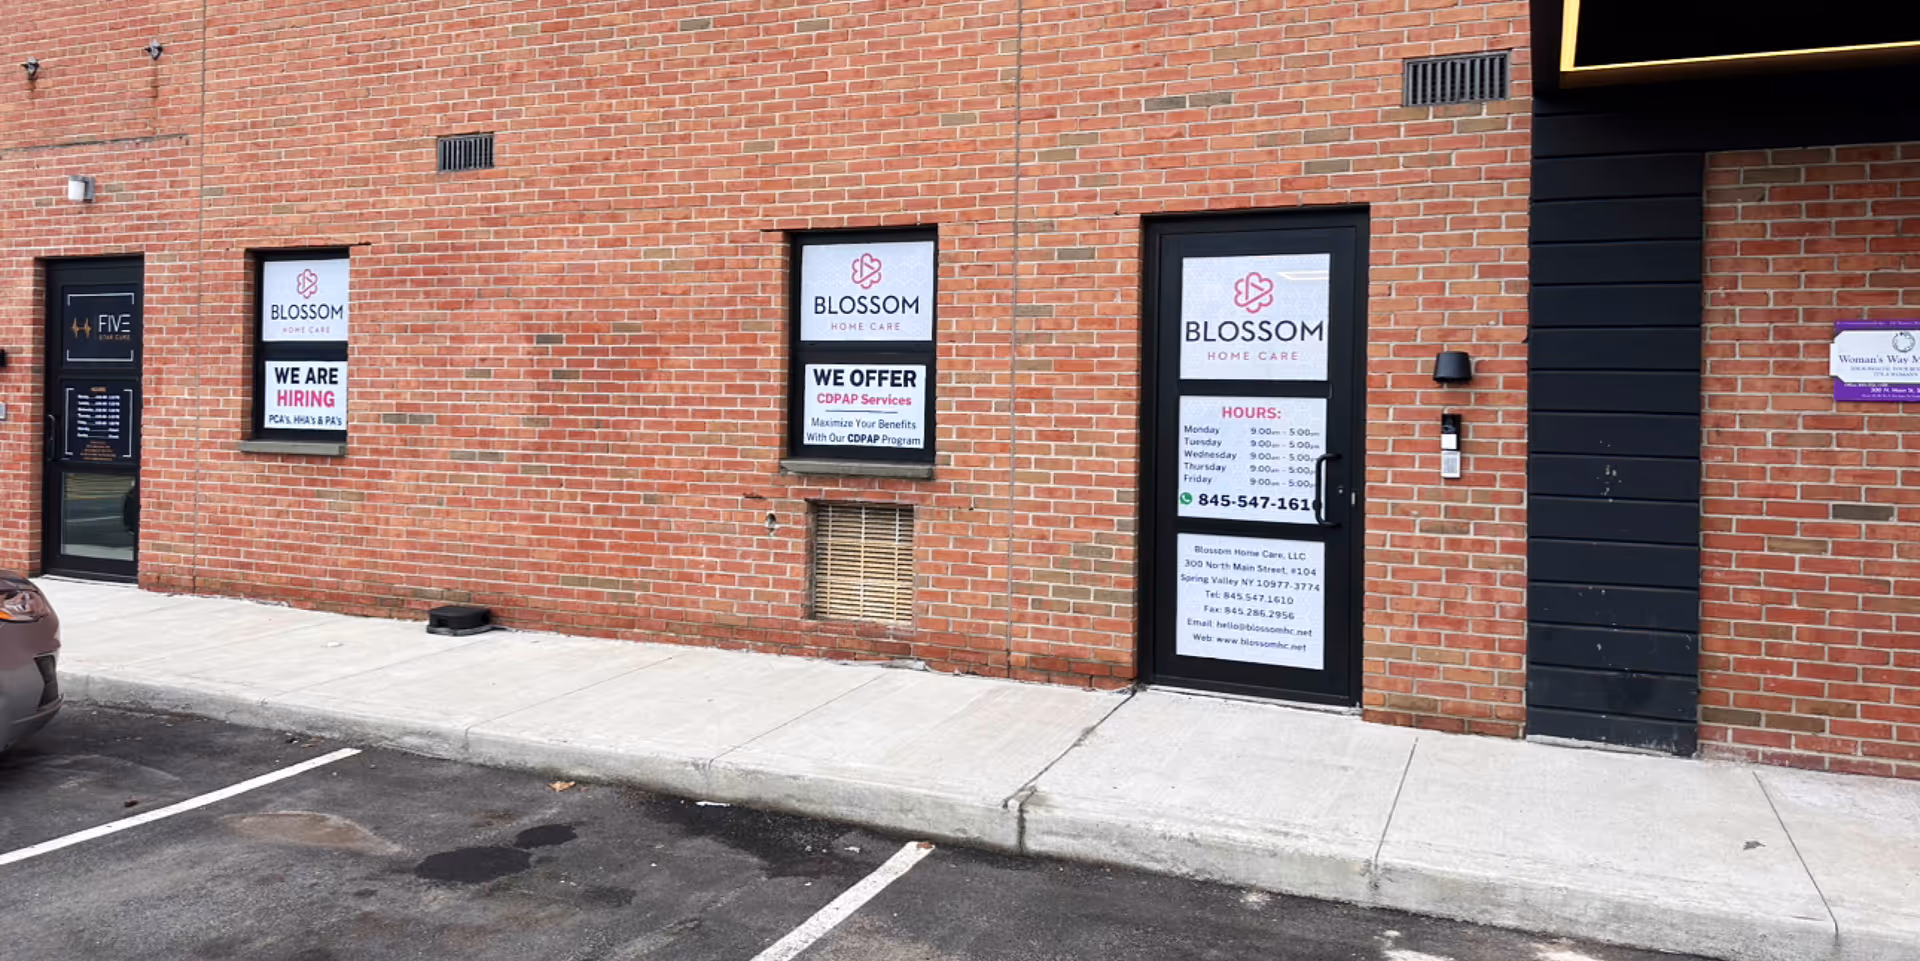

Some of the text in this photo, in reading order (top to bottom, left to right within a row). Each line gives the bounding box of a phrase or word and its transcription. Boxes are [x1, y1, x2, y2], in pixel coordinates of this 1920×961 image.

[814, 295, 919, 315] BLOSSOM
[271, 304, 343, 320] BLOSSOM
[98, 314, 131, 333] FIVE
[282, 326, 330, 334] HOME CARE
[831, 322, 901, 331] HOME CARE
[1186, 320, 1324, 342] BLOSSOM
[1208, 352, 1299, 361] HOME CARE
[1838, 354, 1883, 364] Woman's
[1887, 355, 1908, 364] Way
[274, 367, 339, 385] WE ARE
[813, 368, 917, 387] WE OFFER
[277, 390, 336, 408] HIRING
[816, 393, 912, 406] CDPAP Services
[1221, 406, 1281, 419] HOURS:
[326, 416, 342, 426] PA's
[810, 418, 916, 430] Maximize Your Benefits
[1184, 425, 1220, 435] Monday
[806, 432, 920, 446] With Our CDPAP Program
[1184, 437, 1222, 447] Tuesday
[1184, 450, 1237, 460] Wednesday
[1184, 462, 1226, 472] Thursday
[1184, 474, 1212, 484] Friday
[1194, 545, 1306, 560] Blossom Home Care, LLC
[1184, 559, 1317, 576] 300 North Main Street, #104
[1180, 574, 1320, 592] Spring Valley NY 10977-3774
[1205, 590, 1294, 605] Tel: 845.547.1610
[1204, 605, 1222, 614] Fax:
[1187, 618, 1312, 637] Email: hello@blossomhc.net
[1193, 633, 1307, 651] Web: www.blossomhc.net
